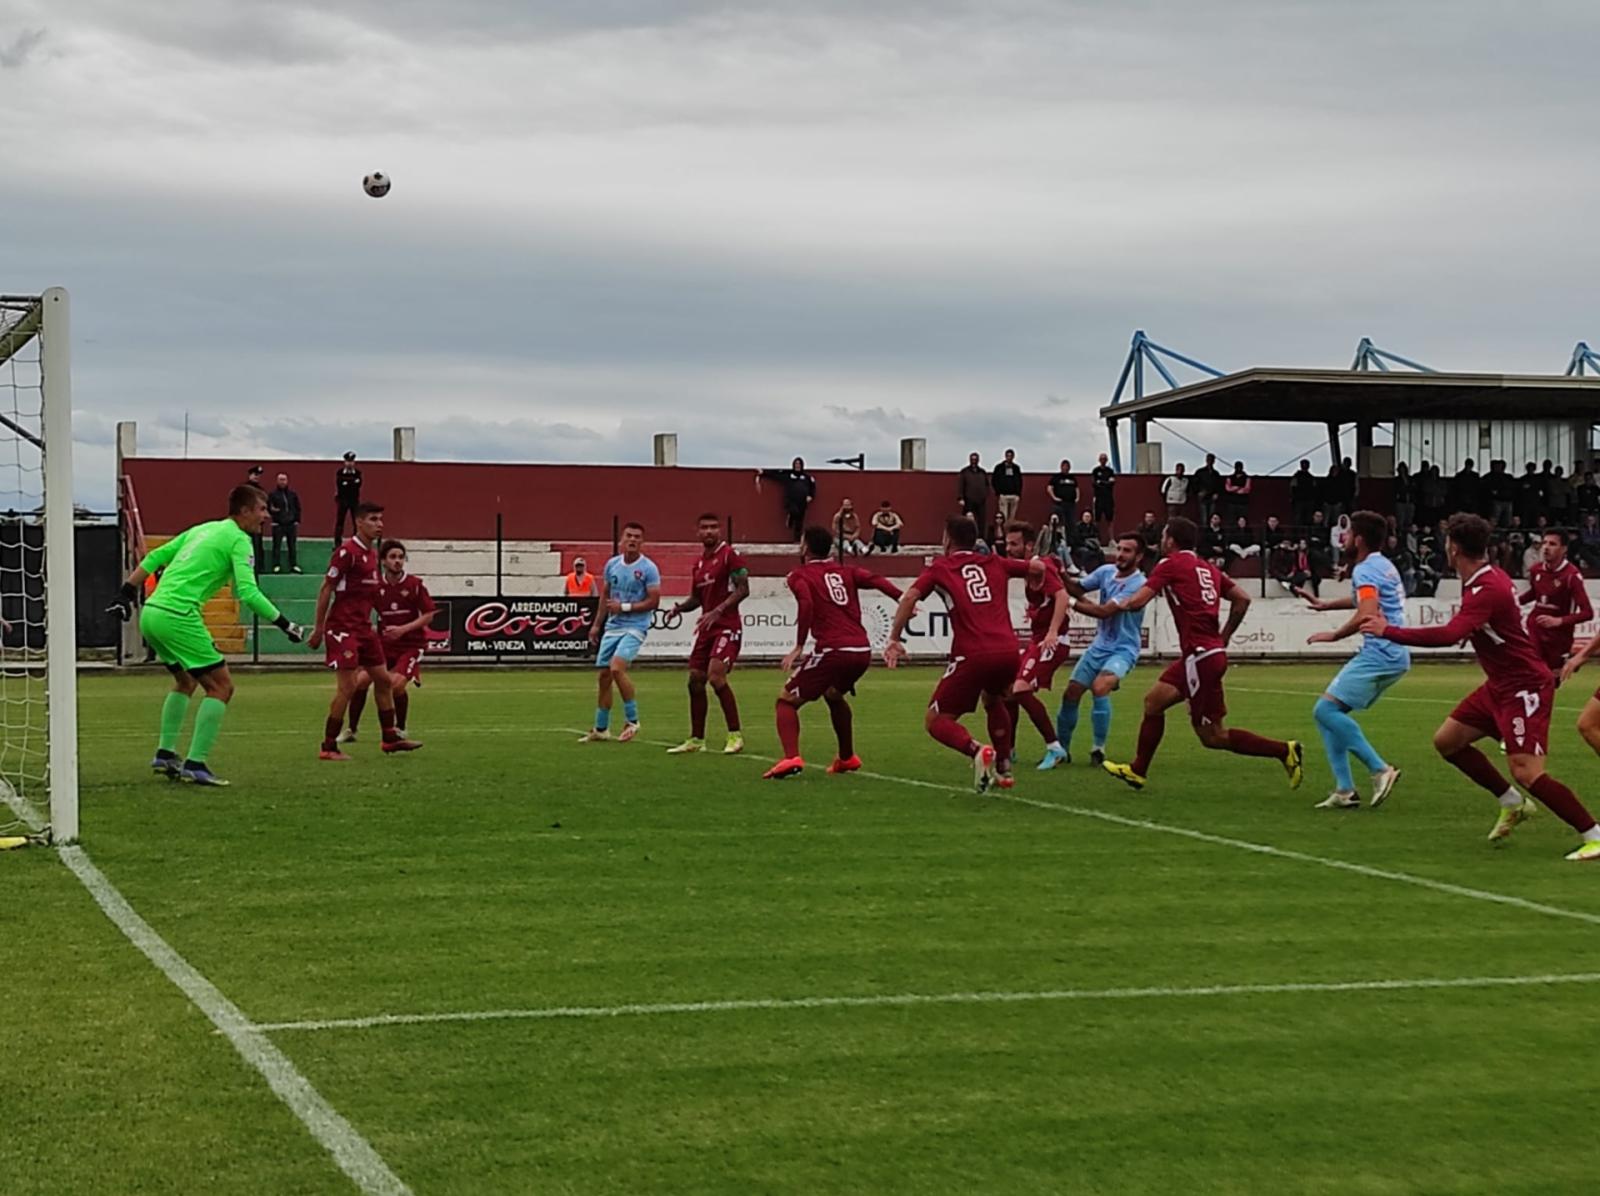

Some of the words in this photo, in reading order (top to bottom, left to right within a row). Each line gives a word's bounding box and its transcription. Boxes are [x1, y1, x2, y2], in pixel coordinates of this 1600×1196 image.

[824, 572, 848, 605] 6
[962, 564, 992, 603] 2
[1196, 566, 1217, 605] 5
[510, 602, 577, 613] ARREDAMENTI
[467, 641, 487, 651] MIRA
[493, 640, 526, 651] VENEZIA
